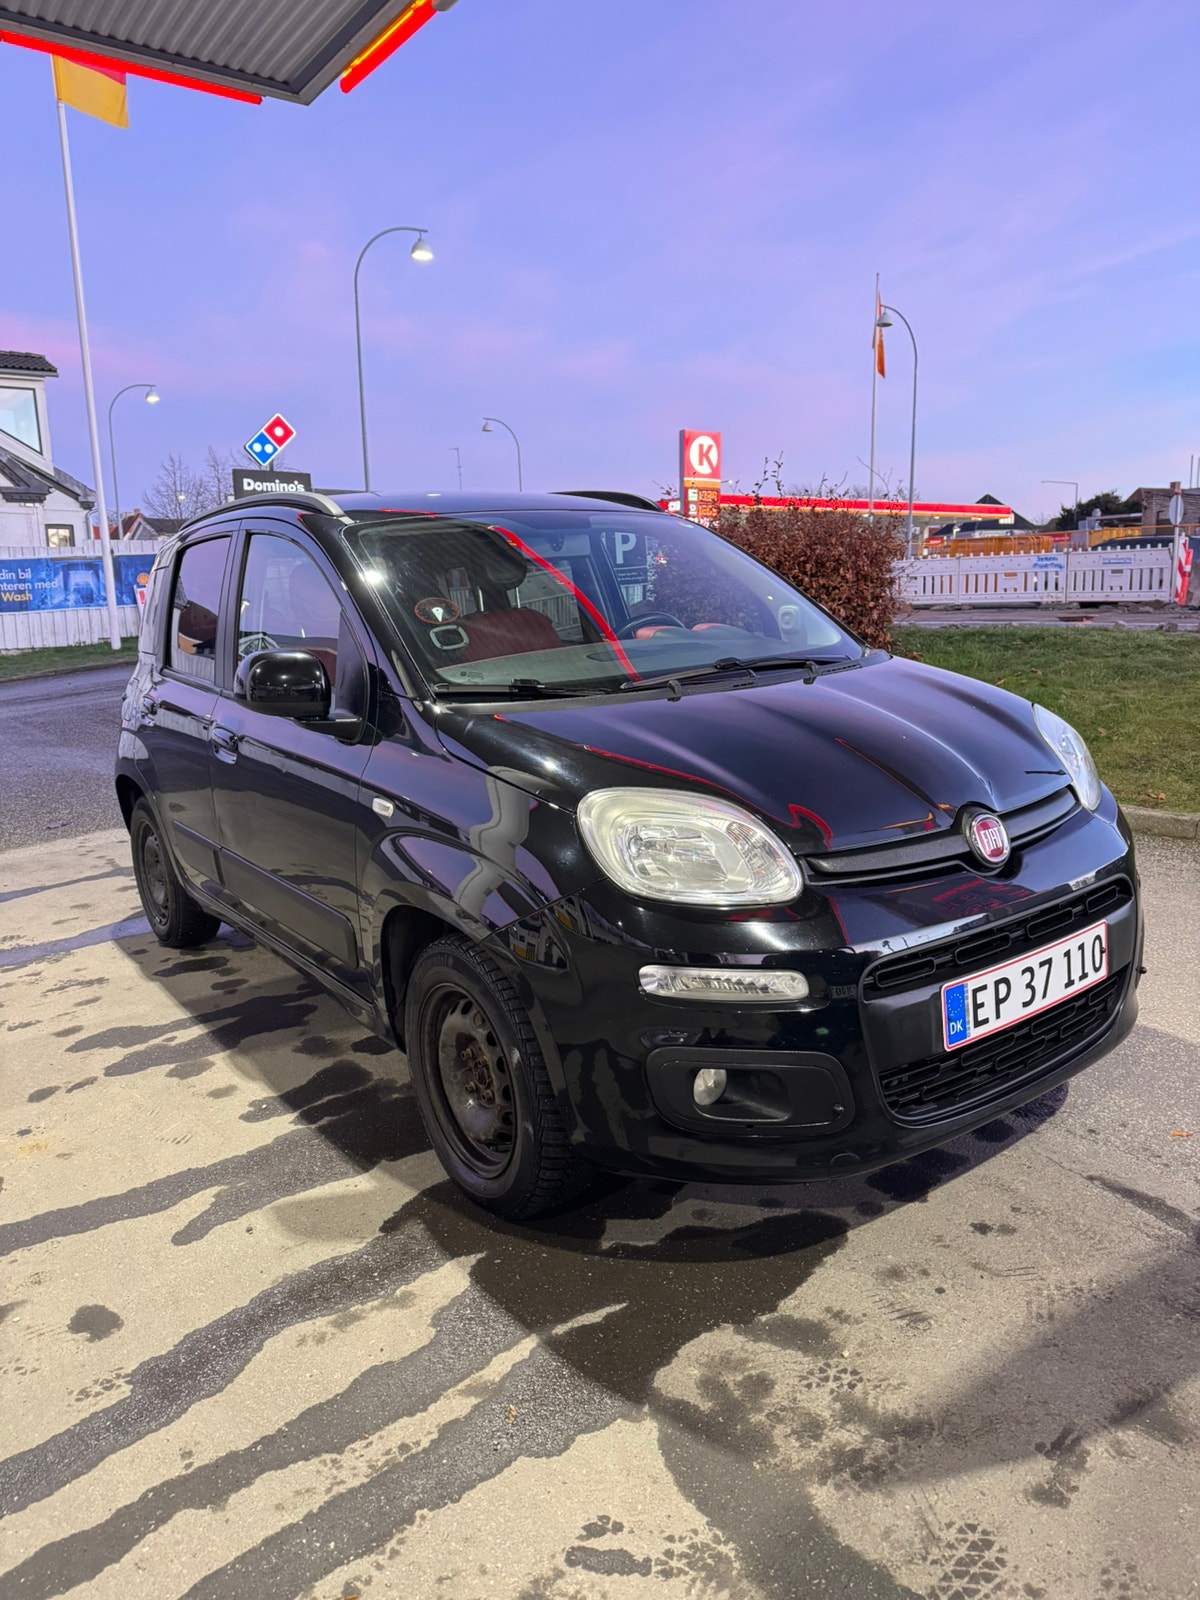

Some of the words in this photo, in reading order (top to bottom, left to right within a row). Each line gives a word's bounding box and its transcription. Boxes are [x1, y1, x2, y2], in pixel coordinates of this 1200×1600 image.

[698, 443, 717, 470] K
[242, 477, 305, 492] Domino's
[615, 532, 637, 565] P
[0, 568, 16, 580] din
[18, 567, 32, 580] bil
[34, 579, 59, 590] med
[1, 590, 33, 602] Wash
[980, 827, 1003, 853] FIAT
[971, 976, 1012, 1029] EP
[1021, 957, 1053, 1009] 37
[1063, 934, 1104, 990] 110
[950, 1019, 964, 1035] DK
